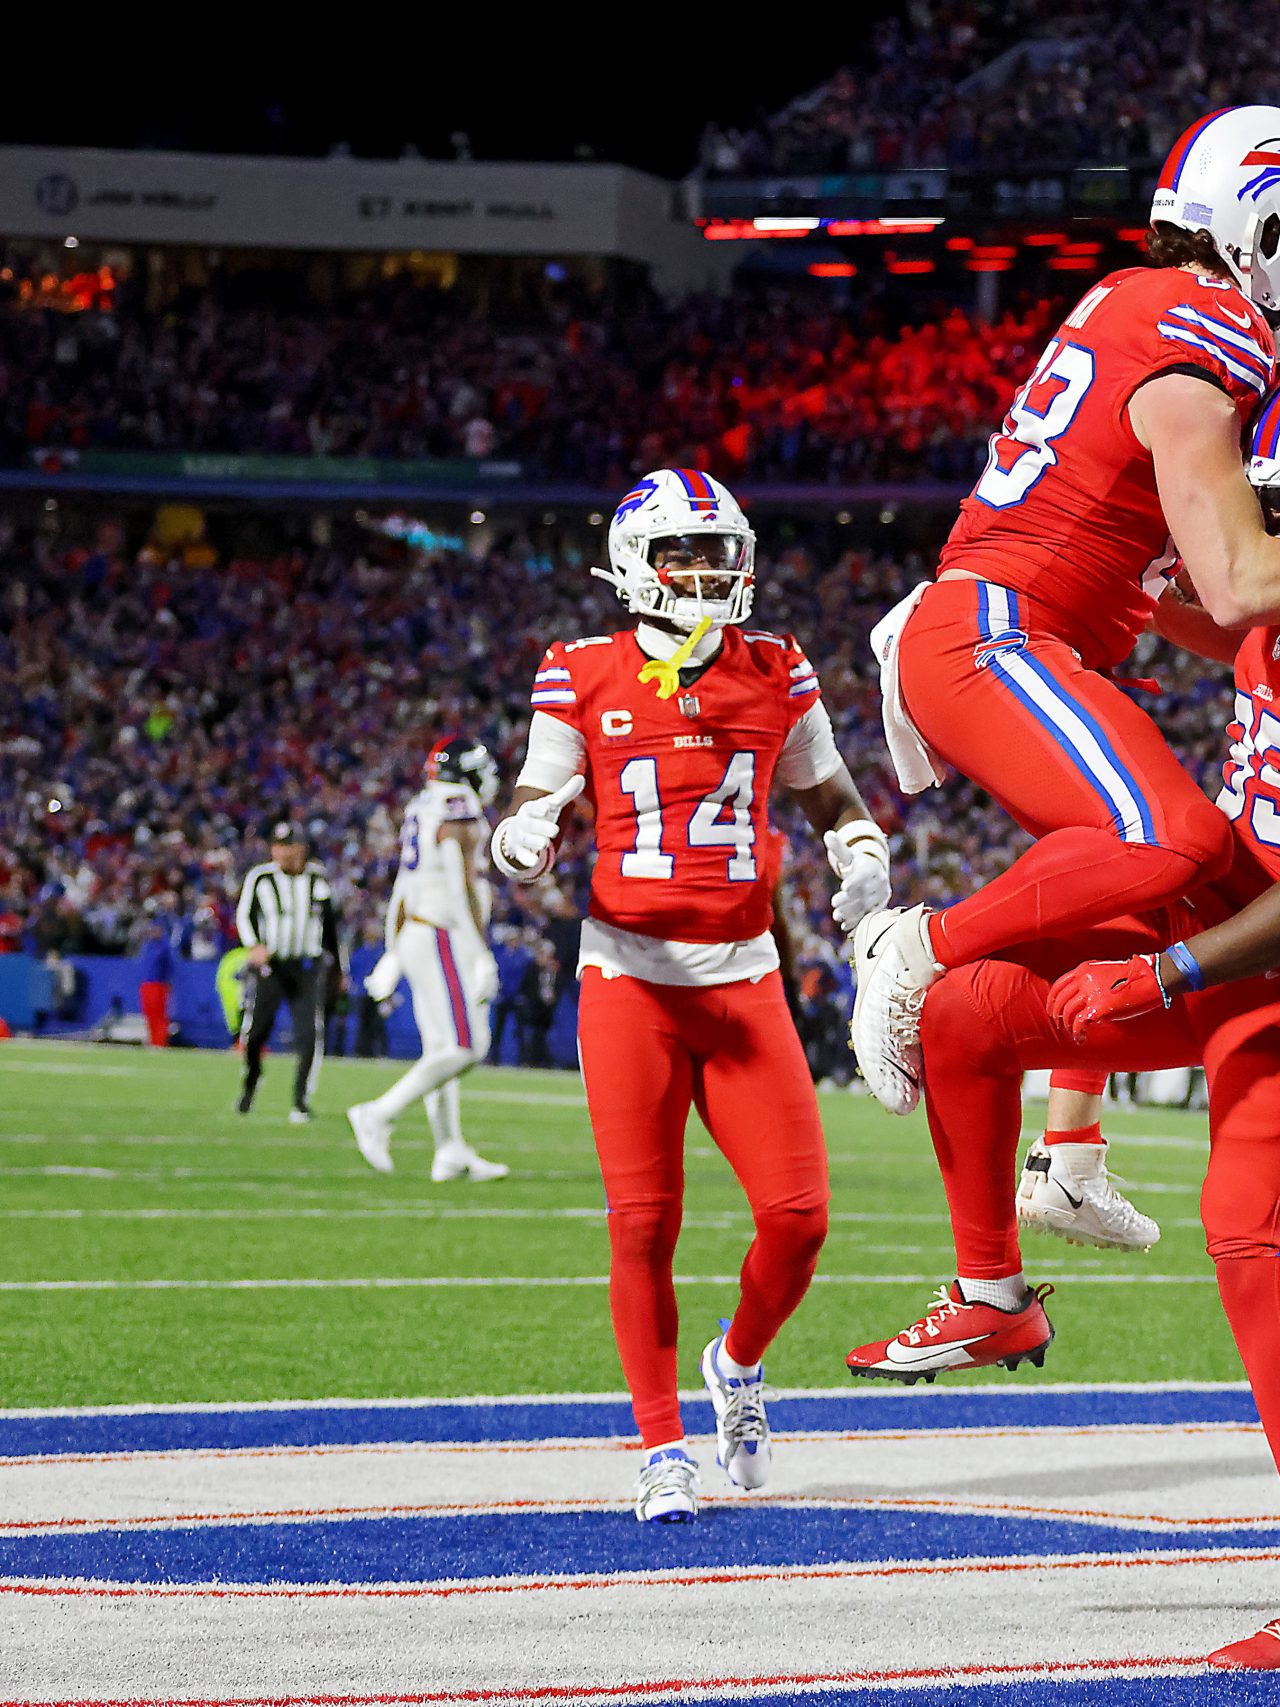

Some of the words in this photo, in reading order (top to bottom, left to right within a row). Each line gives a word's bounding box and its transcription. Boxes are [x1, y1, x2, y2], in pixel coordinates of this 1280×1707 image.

[600, 710, 634, 737] C
[673, 736, 713, 748] BILLS
[620, 750, 758, 882] 14
